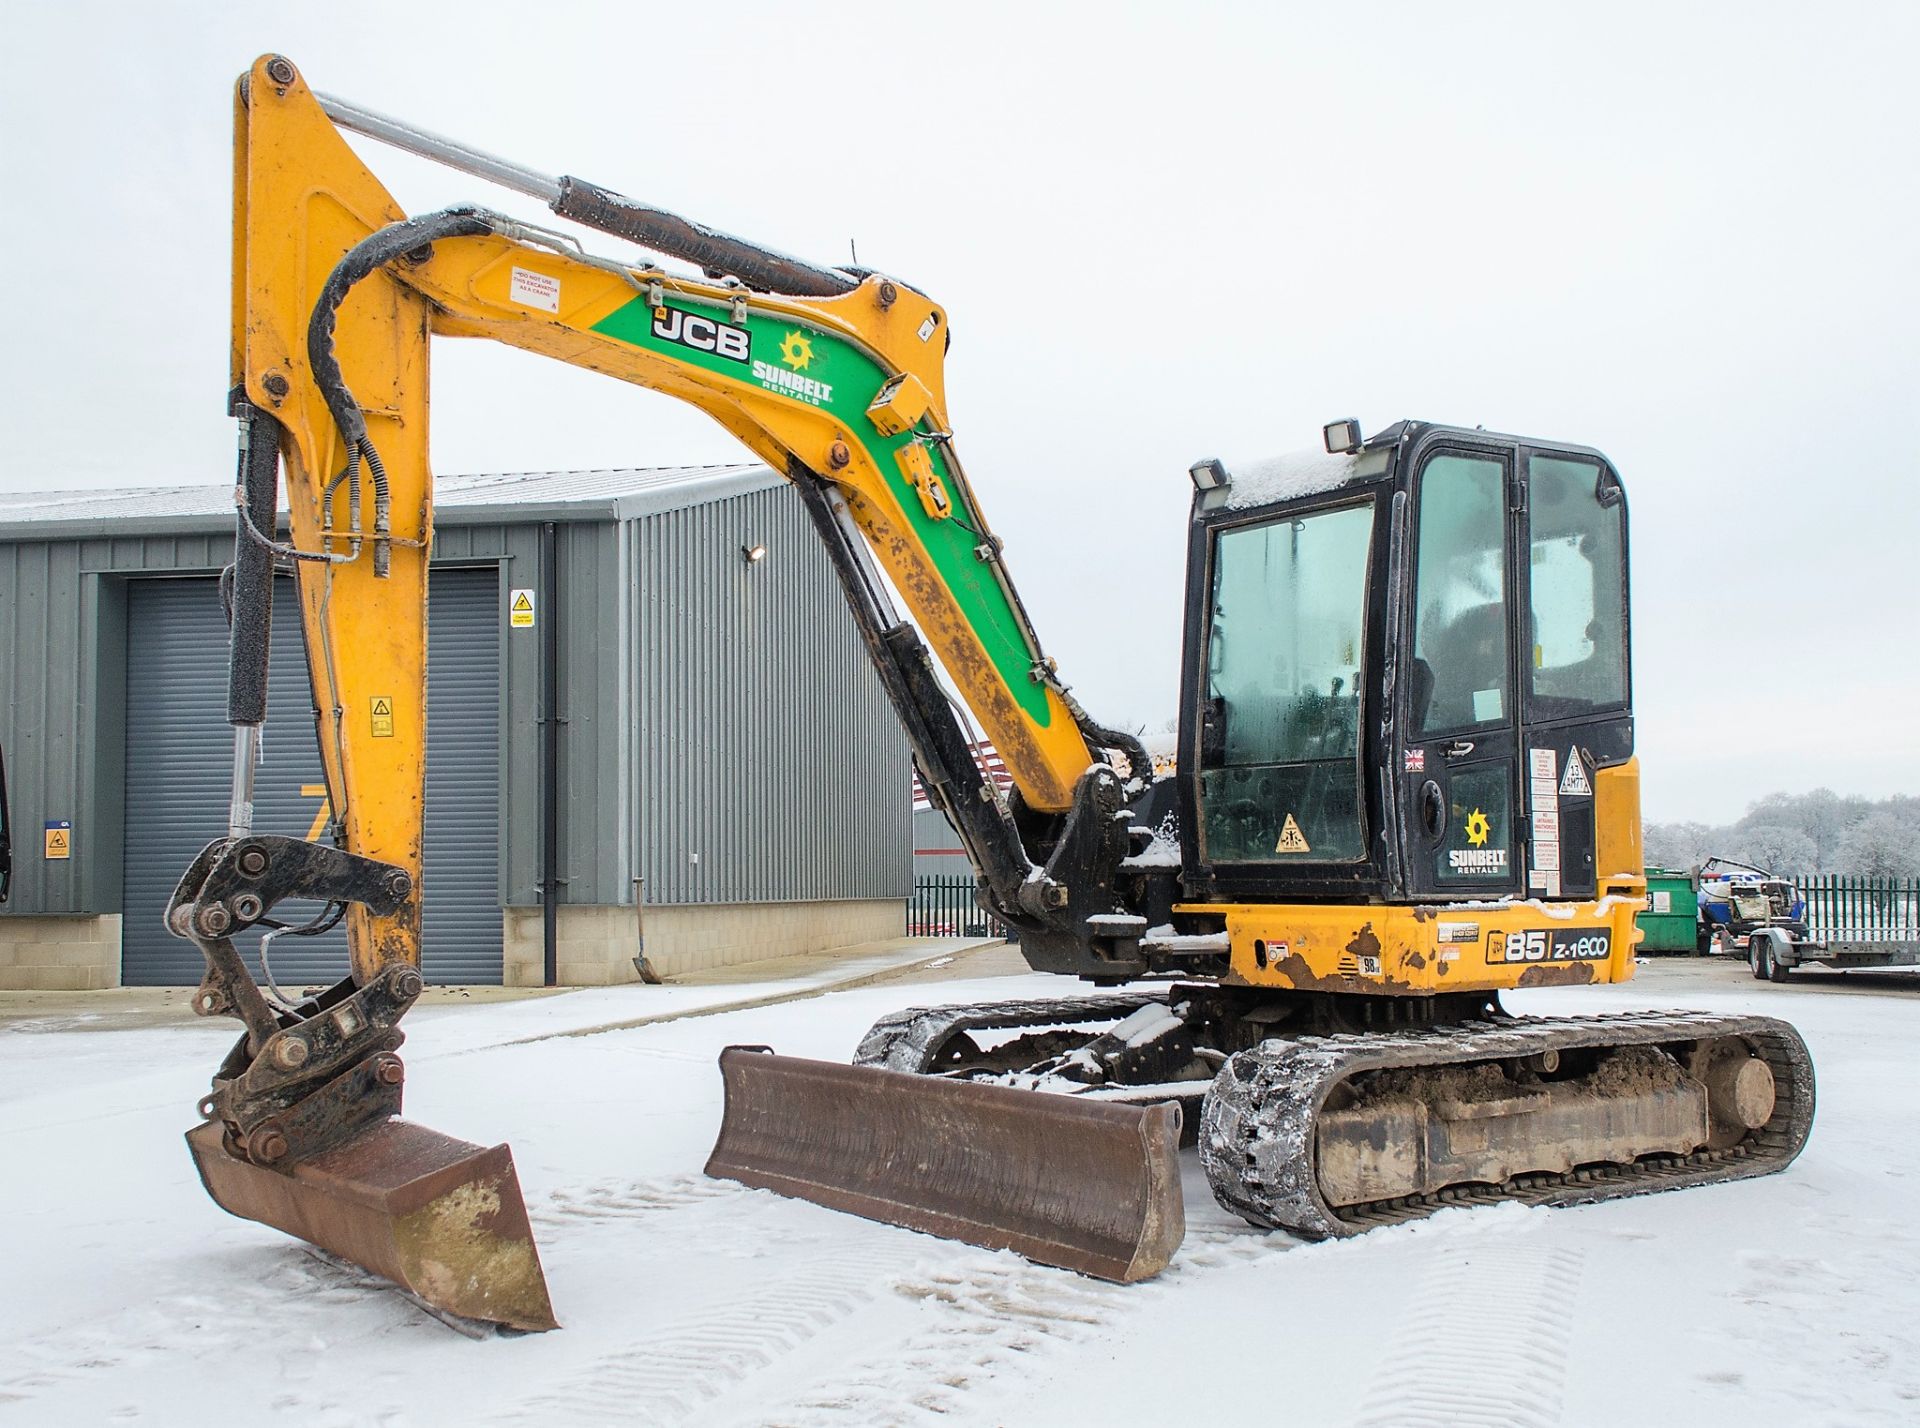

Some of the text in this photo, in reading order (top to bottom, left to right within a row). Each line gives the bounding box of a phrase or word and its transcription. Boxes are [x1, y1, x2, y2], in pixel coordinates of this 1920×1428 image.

[526, 280, 558, 293] EXCAVATOR
[654, 310, 749, 360] JCB
[752, 360, 833, 402] SUNBELT
[762, 380, 819, 406] RENTALS
[1570, 765, 1580, 777] 13
[300, 785, 332, 842] 7
[1449, 849, 1506, 867] SUNBELT
[1457, 866, 1498, 874] RENTALS
[1505, 931, 1546, 961] 85
[1363, 957, 1375, 973] 98
